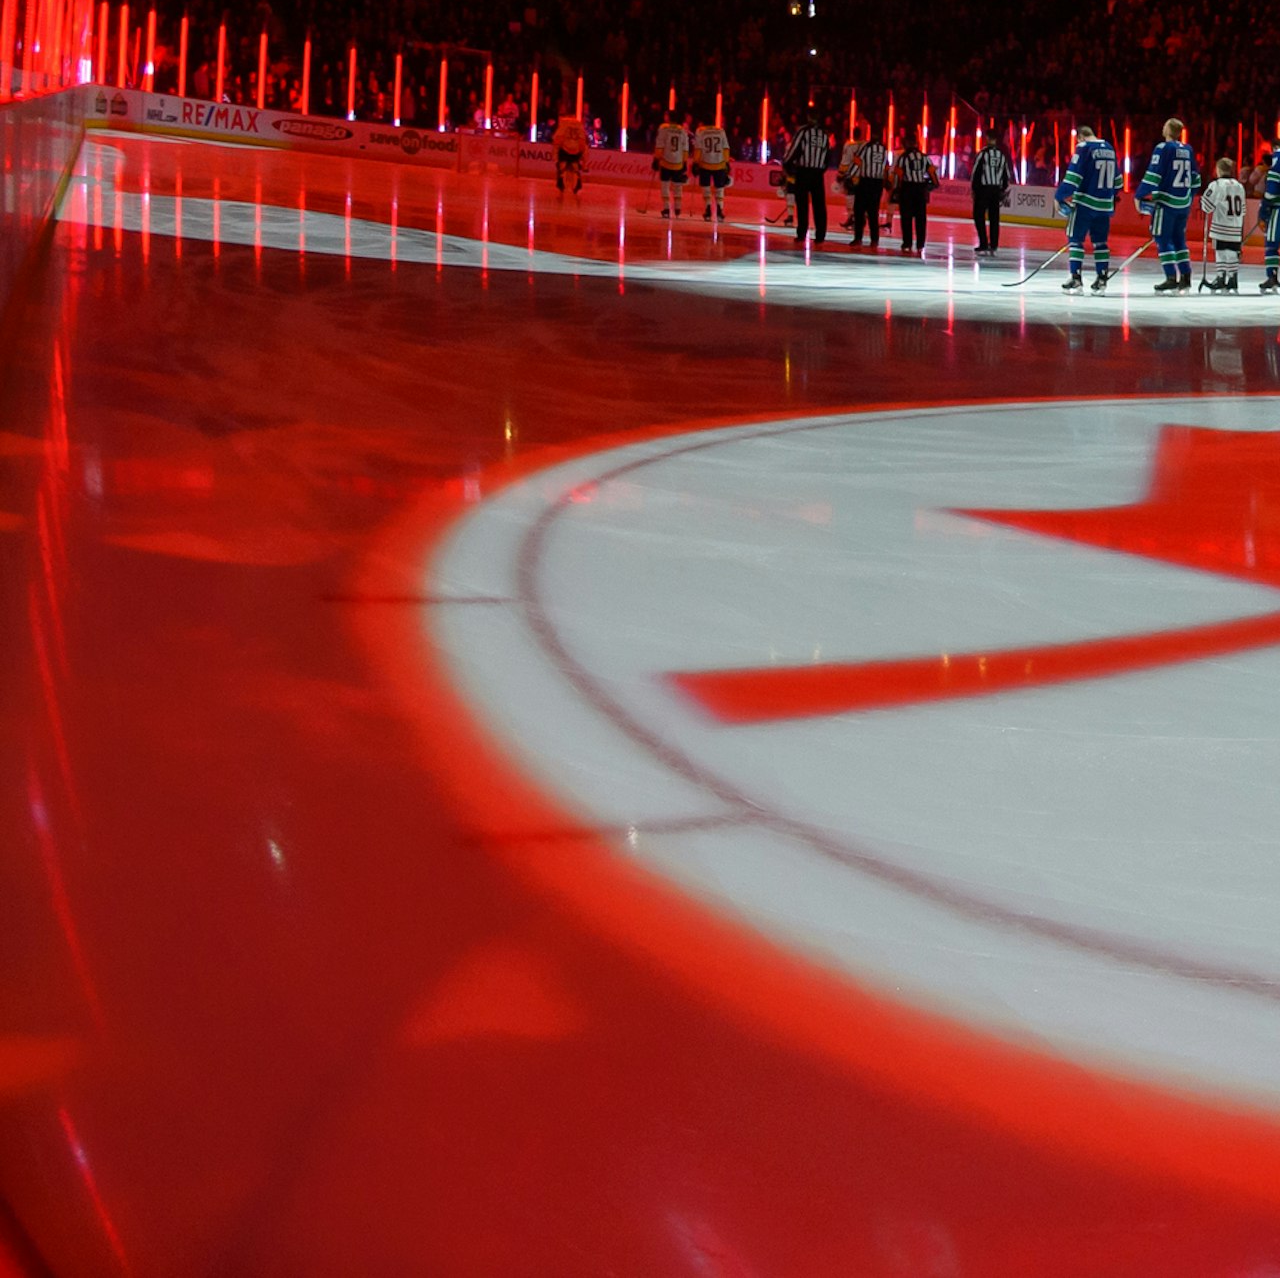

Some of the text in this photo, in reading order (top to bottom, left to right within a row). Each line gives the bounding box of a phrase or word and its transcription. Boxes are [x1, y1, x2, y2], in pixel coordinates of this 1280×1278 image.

[181, 102, 259, 133] RE/MAX
[279, 121, 348, 140] panago
[369, 131, 400, 146] save
[671, 136, 679, 152] 9
[704, 137, 721, 153] 92
[510, 149, 553, 162] CANAD
[1172, 160, 1191, 188] 23
[1017, 193, 1046, 208] SPORTS
[1226, 195, 1241, 217] 10
